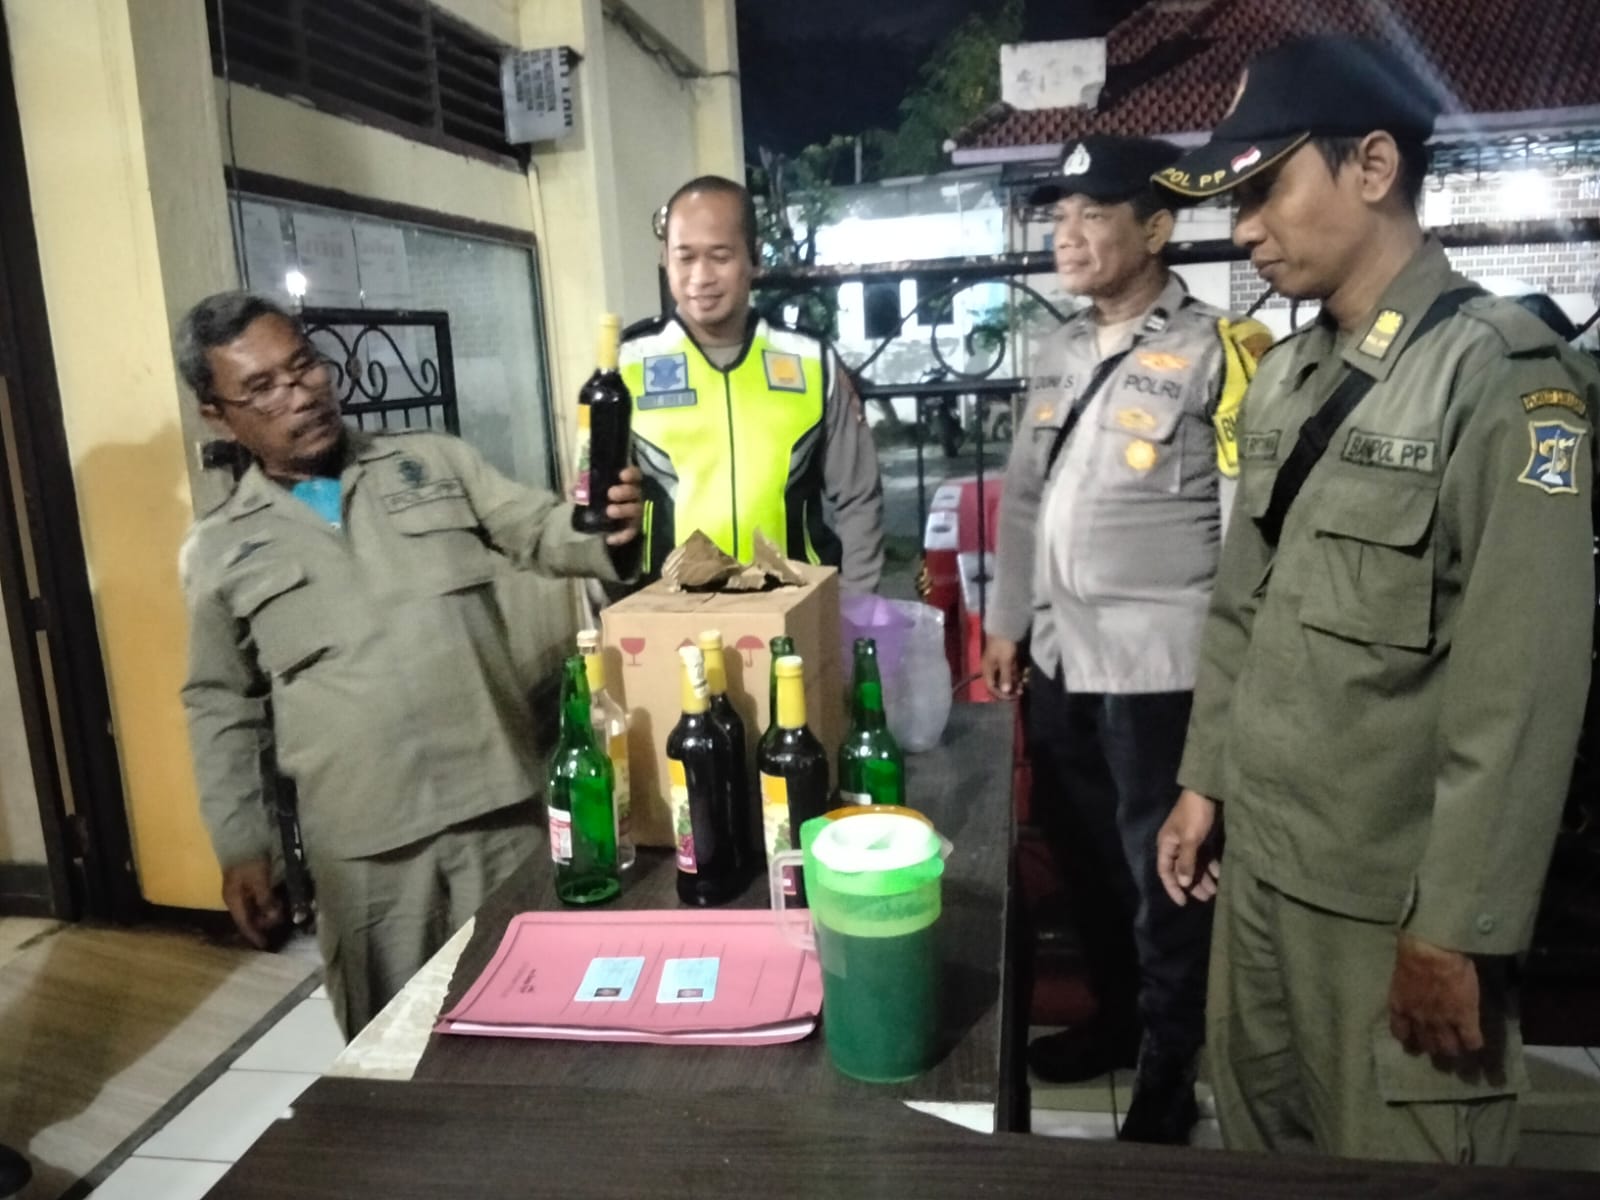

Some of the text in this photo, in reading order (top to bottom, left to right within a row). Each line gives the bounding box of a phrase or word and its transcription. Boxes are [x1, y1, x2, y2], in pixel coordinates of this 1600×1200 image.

[1161, 168, 1227, 188] POL PP
[1123, 374, 1183, 399] POLRI
[1400, 443, 1428, 467] PP
